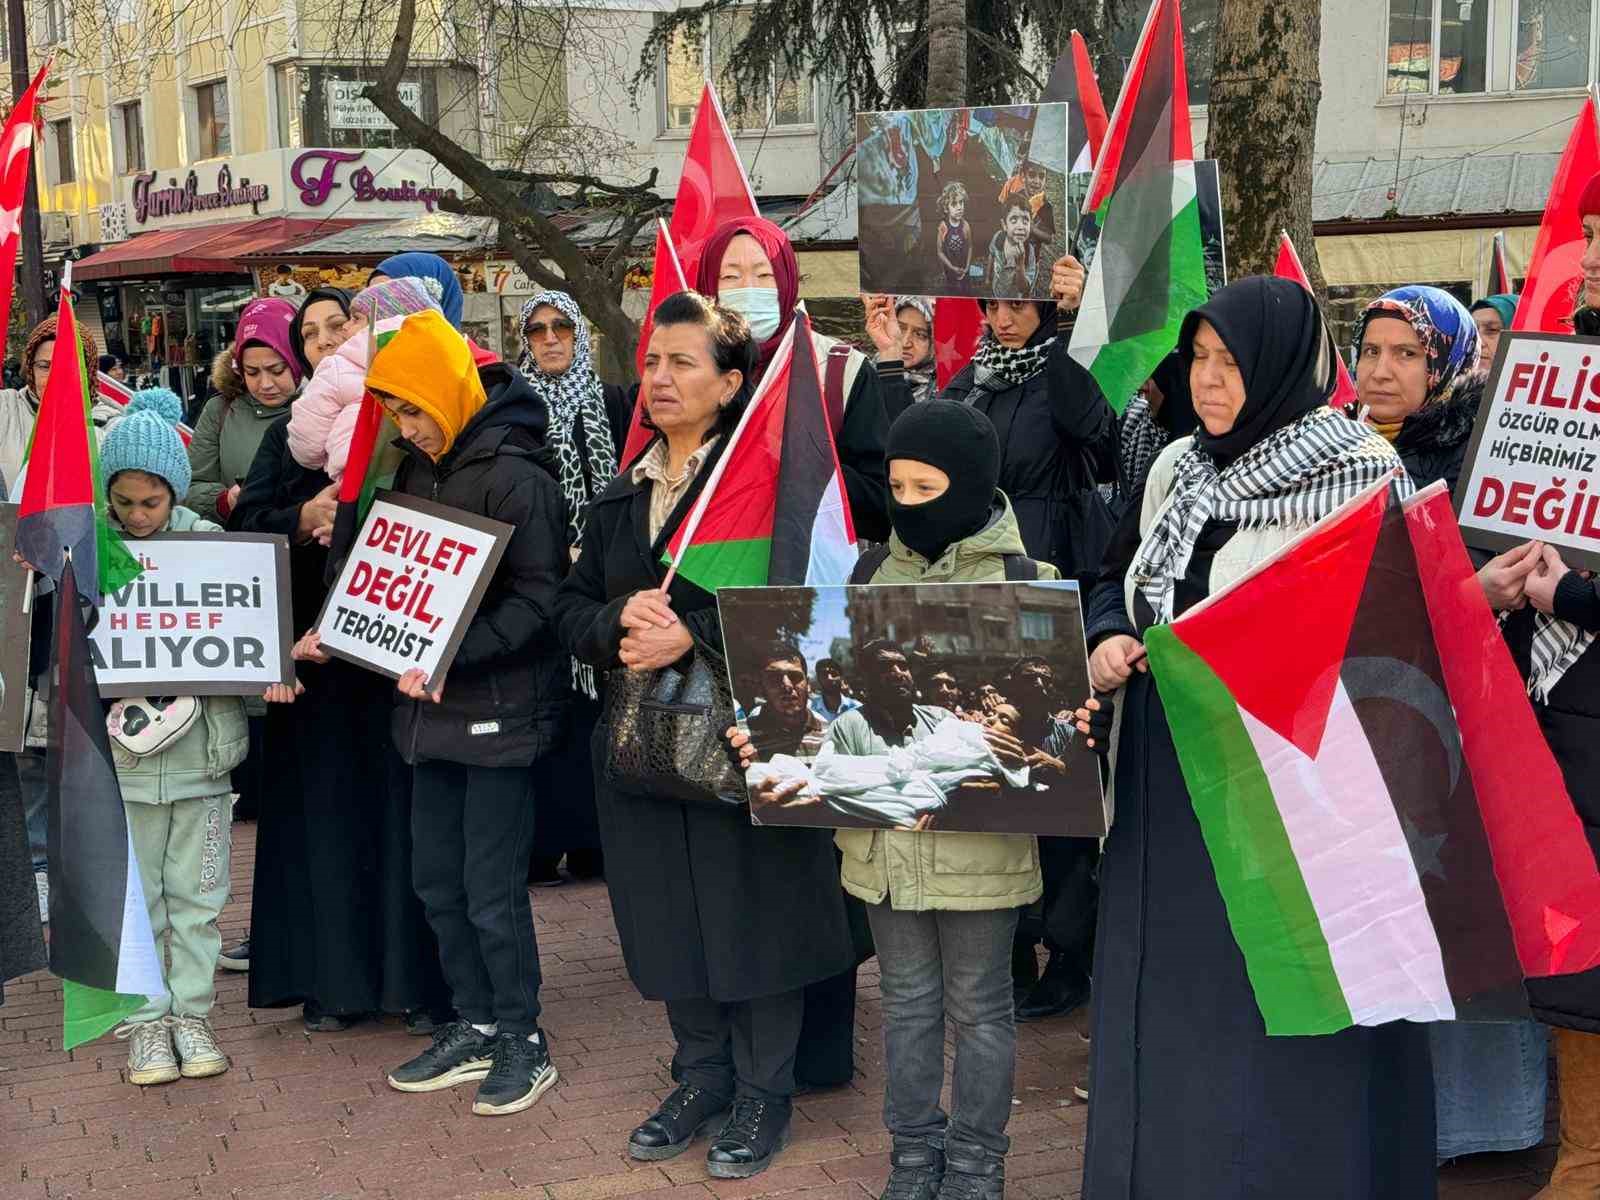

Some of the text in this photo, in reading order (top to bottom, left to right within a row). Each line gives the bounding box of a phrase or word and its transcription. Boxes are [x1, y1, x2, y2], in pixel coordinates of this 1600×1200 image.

[291, 150, 366, 207] F
[1498, 408, 1560, 436] ÖZGÜR
[1489, 436, 1597, 473] HİÇBİRİMİZ
[1473, 476, 1600, 540] DEĞİL
[366, 517, 477, 576] DEVLET
[98, 576, 261, 608] VİLLERİ
[346, 559, 444, 634] DEĞİL,
[110, 612, 223, 630] HEDEF
[332, 606, 433, 662] TERÖRİST
